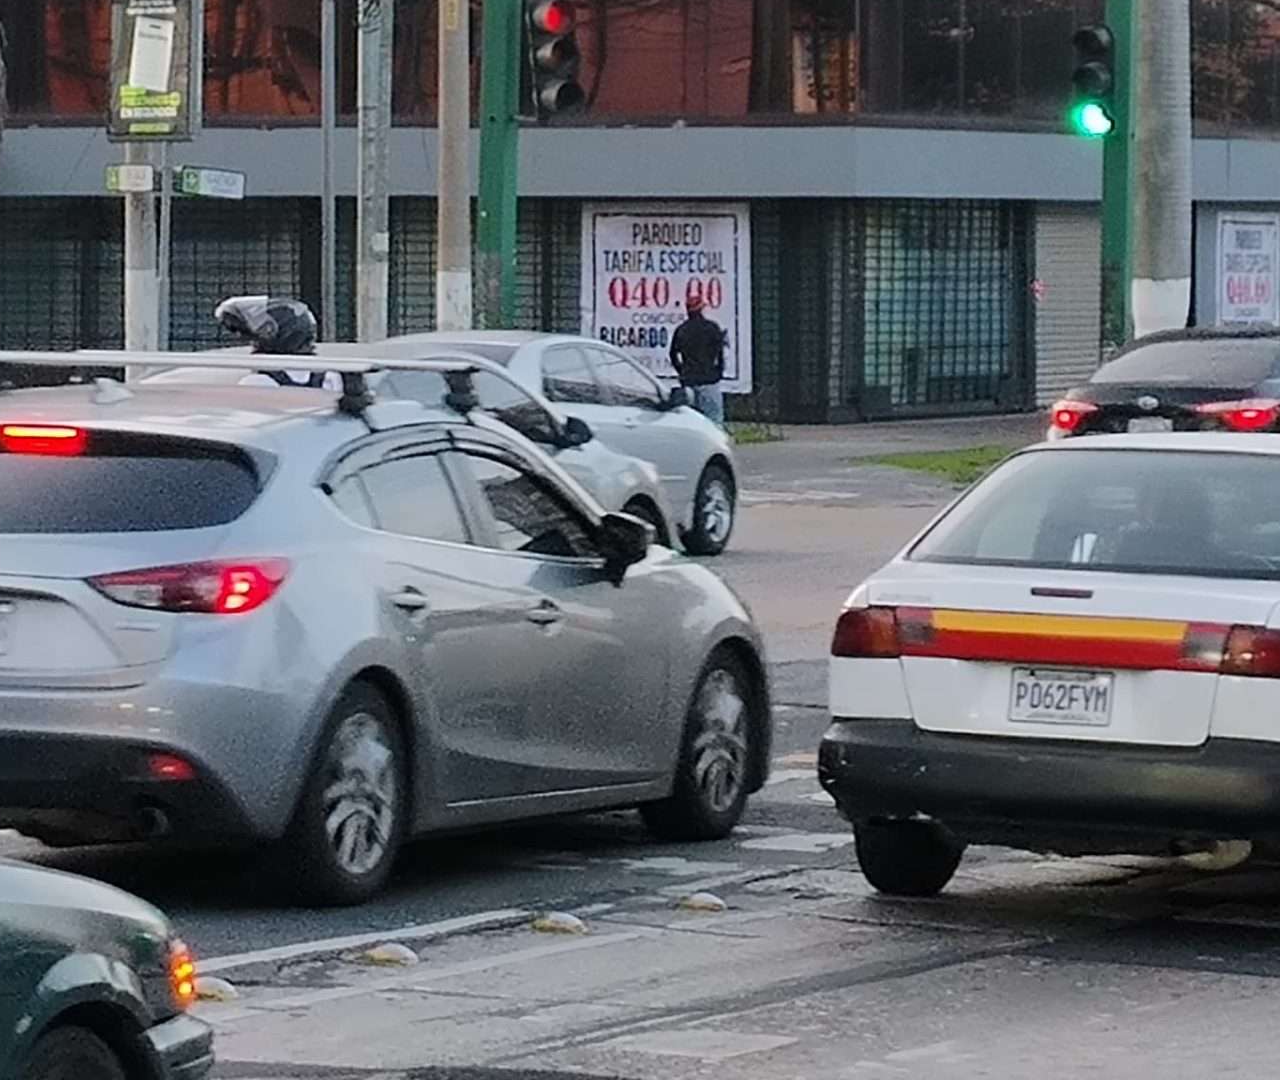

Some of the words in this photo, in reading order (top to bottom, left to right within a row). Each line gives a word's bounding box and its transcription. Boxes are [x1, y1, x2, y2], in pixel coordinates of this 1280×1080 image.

[632, 222, 702, 246] PARQUEO
[604, 250, 656, 273] TARIFA
[660, 251, 726, 274] ESPECIAL
[608, 276, 723, 309] Q40.00
[631, 311, 686, 324] CONCIER
[600, 326, 668, 348] RICARDO
[1016, 682, 1108, 713] P062FYM
